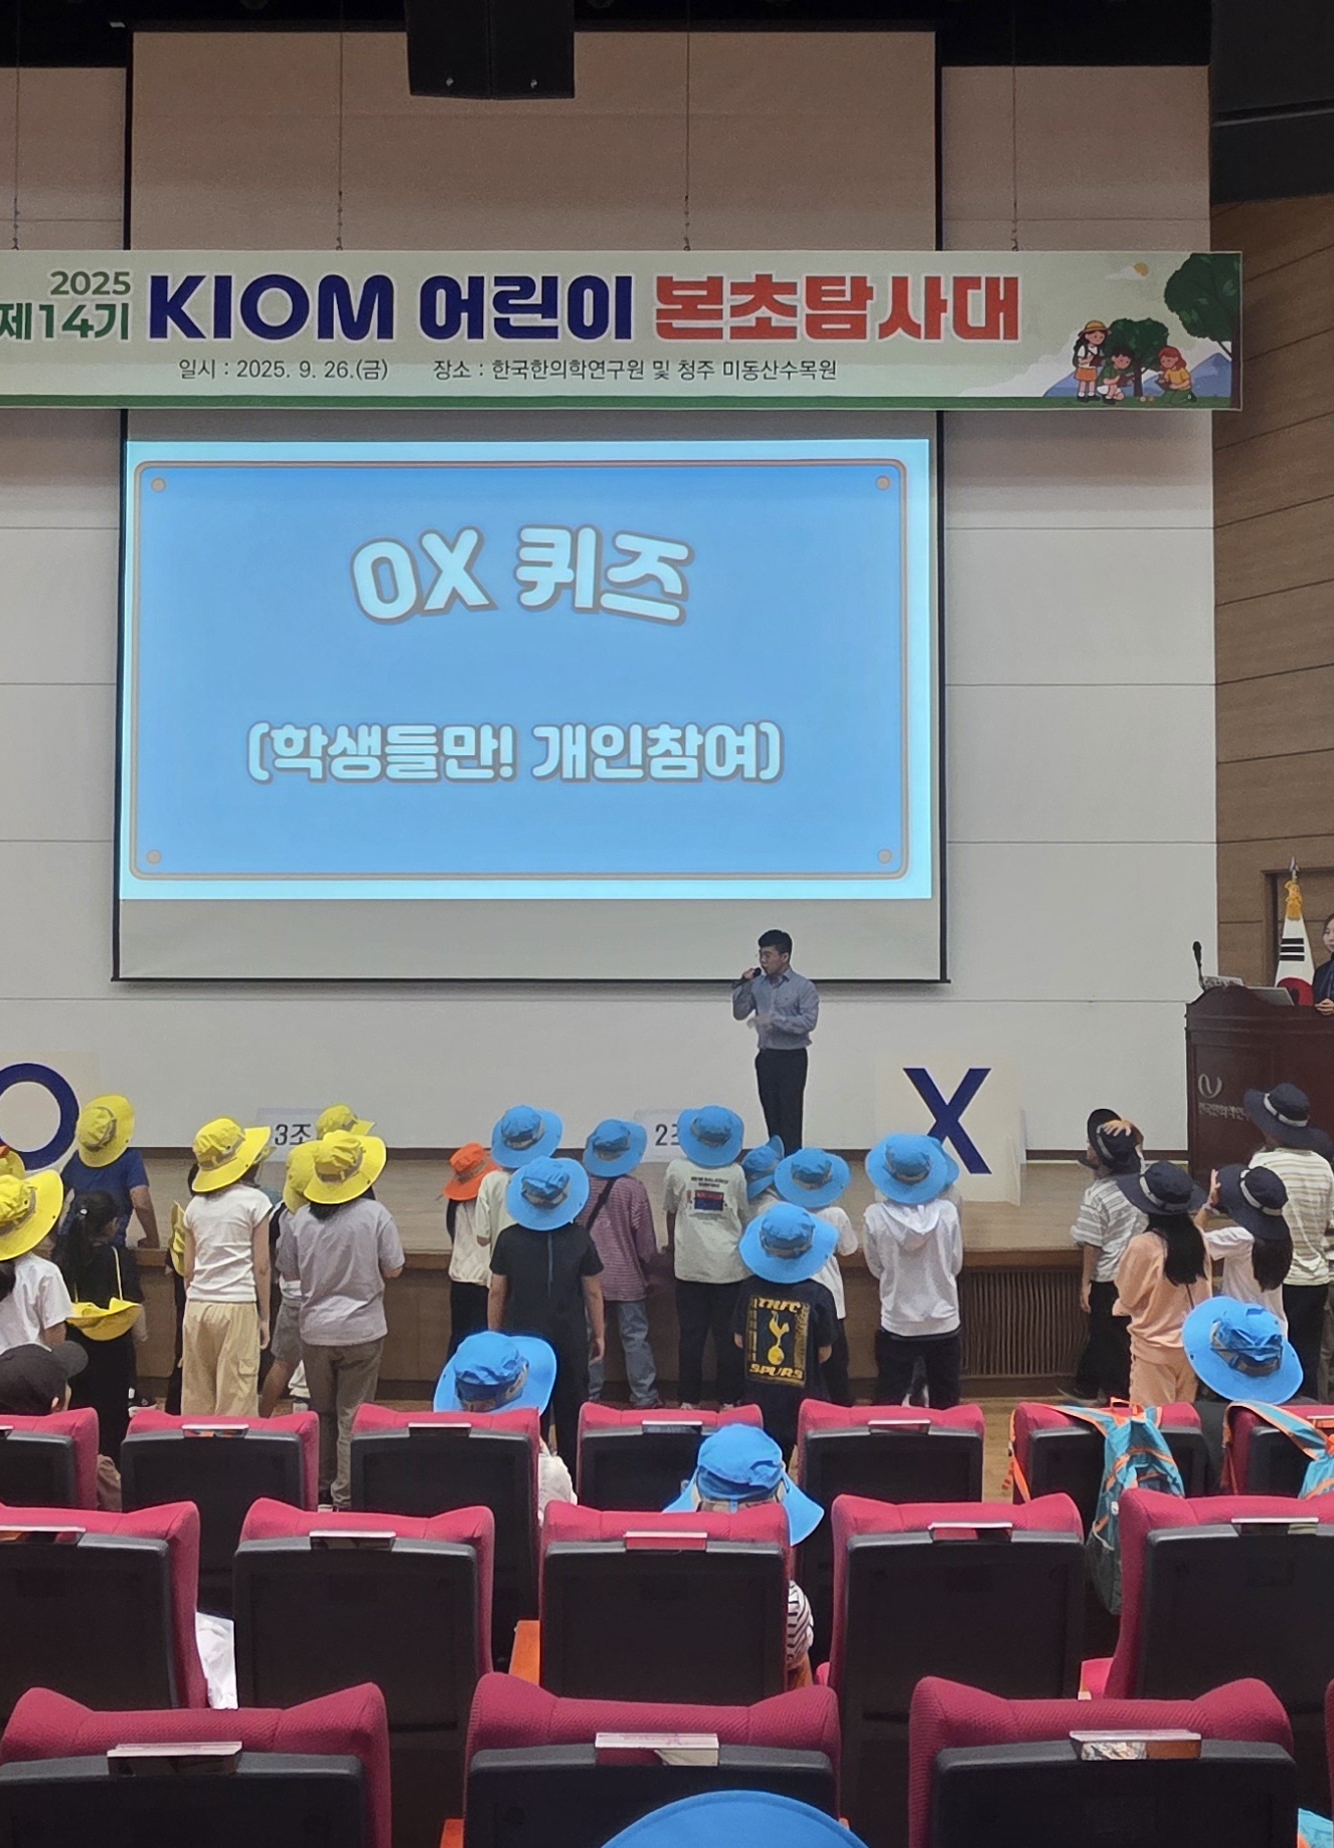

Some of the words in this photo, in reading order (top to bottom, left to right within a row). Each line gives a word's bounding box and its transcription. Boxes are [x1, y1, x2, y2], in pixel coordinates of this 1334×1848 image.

[50, 271, 131, 296] 2025
[150, 274, 394, 340] KIOM
[419, 275, 632, 340] 어린이
[655, 275, 1020, 341] 본초탐사대
[178, 359, 216, 380] 일시
[236, 359, 290, 379] 2025.
[299, 360, 317, 379] 9.
[324, 358, 388, 380] 26.(금)
[433, 359, 471, 380] 장소
[491, 359, 644, 381] 한국한의학연구원
[652, 359, 670, 380] 및
[677, 359, 715, 380] 청주
[722, 359, 837, 381] 미동산수목원
[351, 526, 491, 620] OX
[515, 525, 692, 624] 퀴즈
[247, 722, 515, 783] (학생들만!
[531, 722, 783, 783] 개인참여)
[902, 1067, 993, 1175] X
[274, 1123, 312, 1146] 3조
[749, 1363, 804, 1380] SPURS
